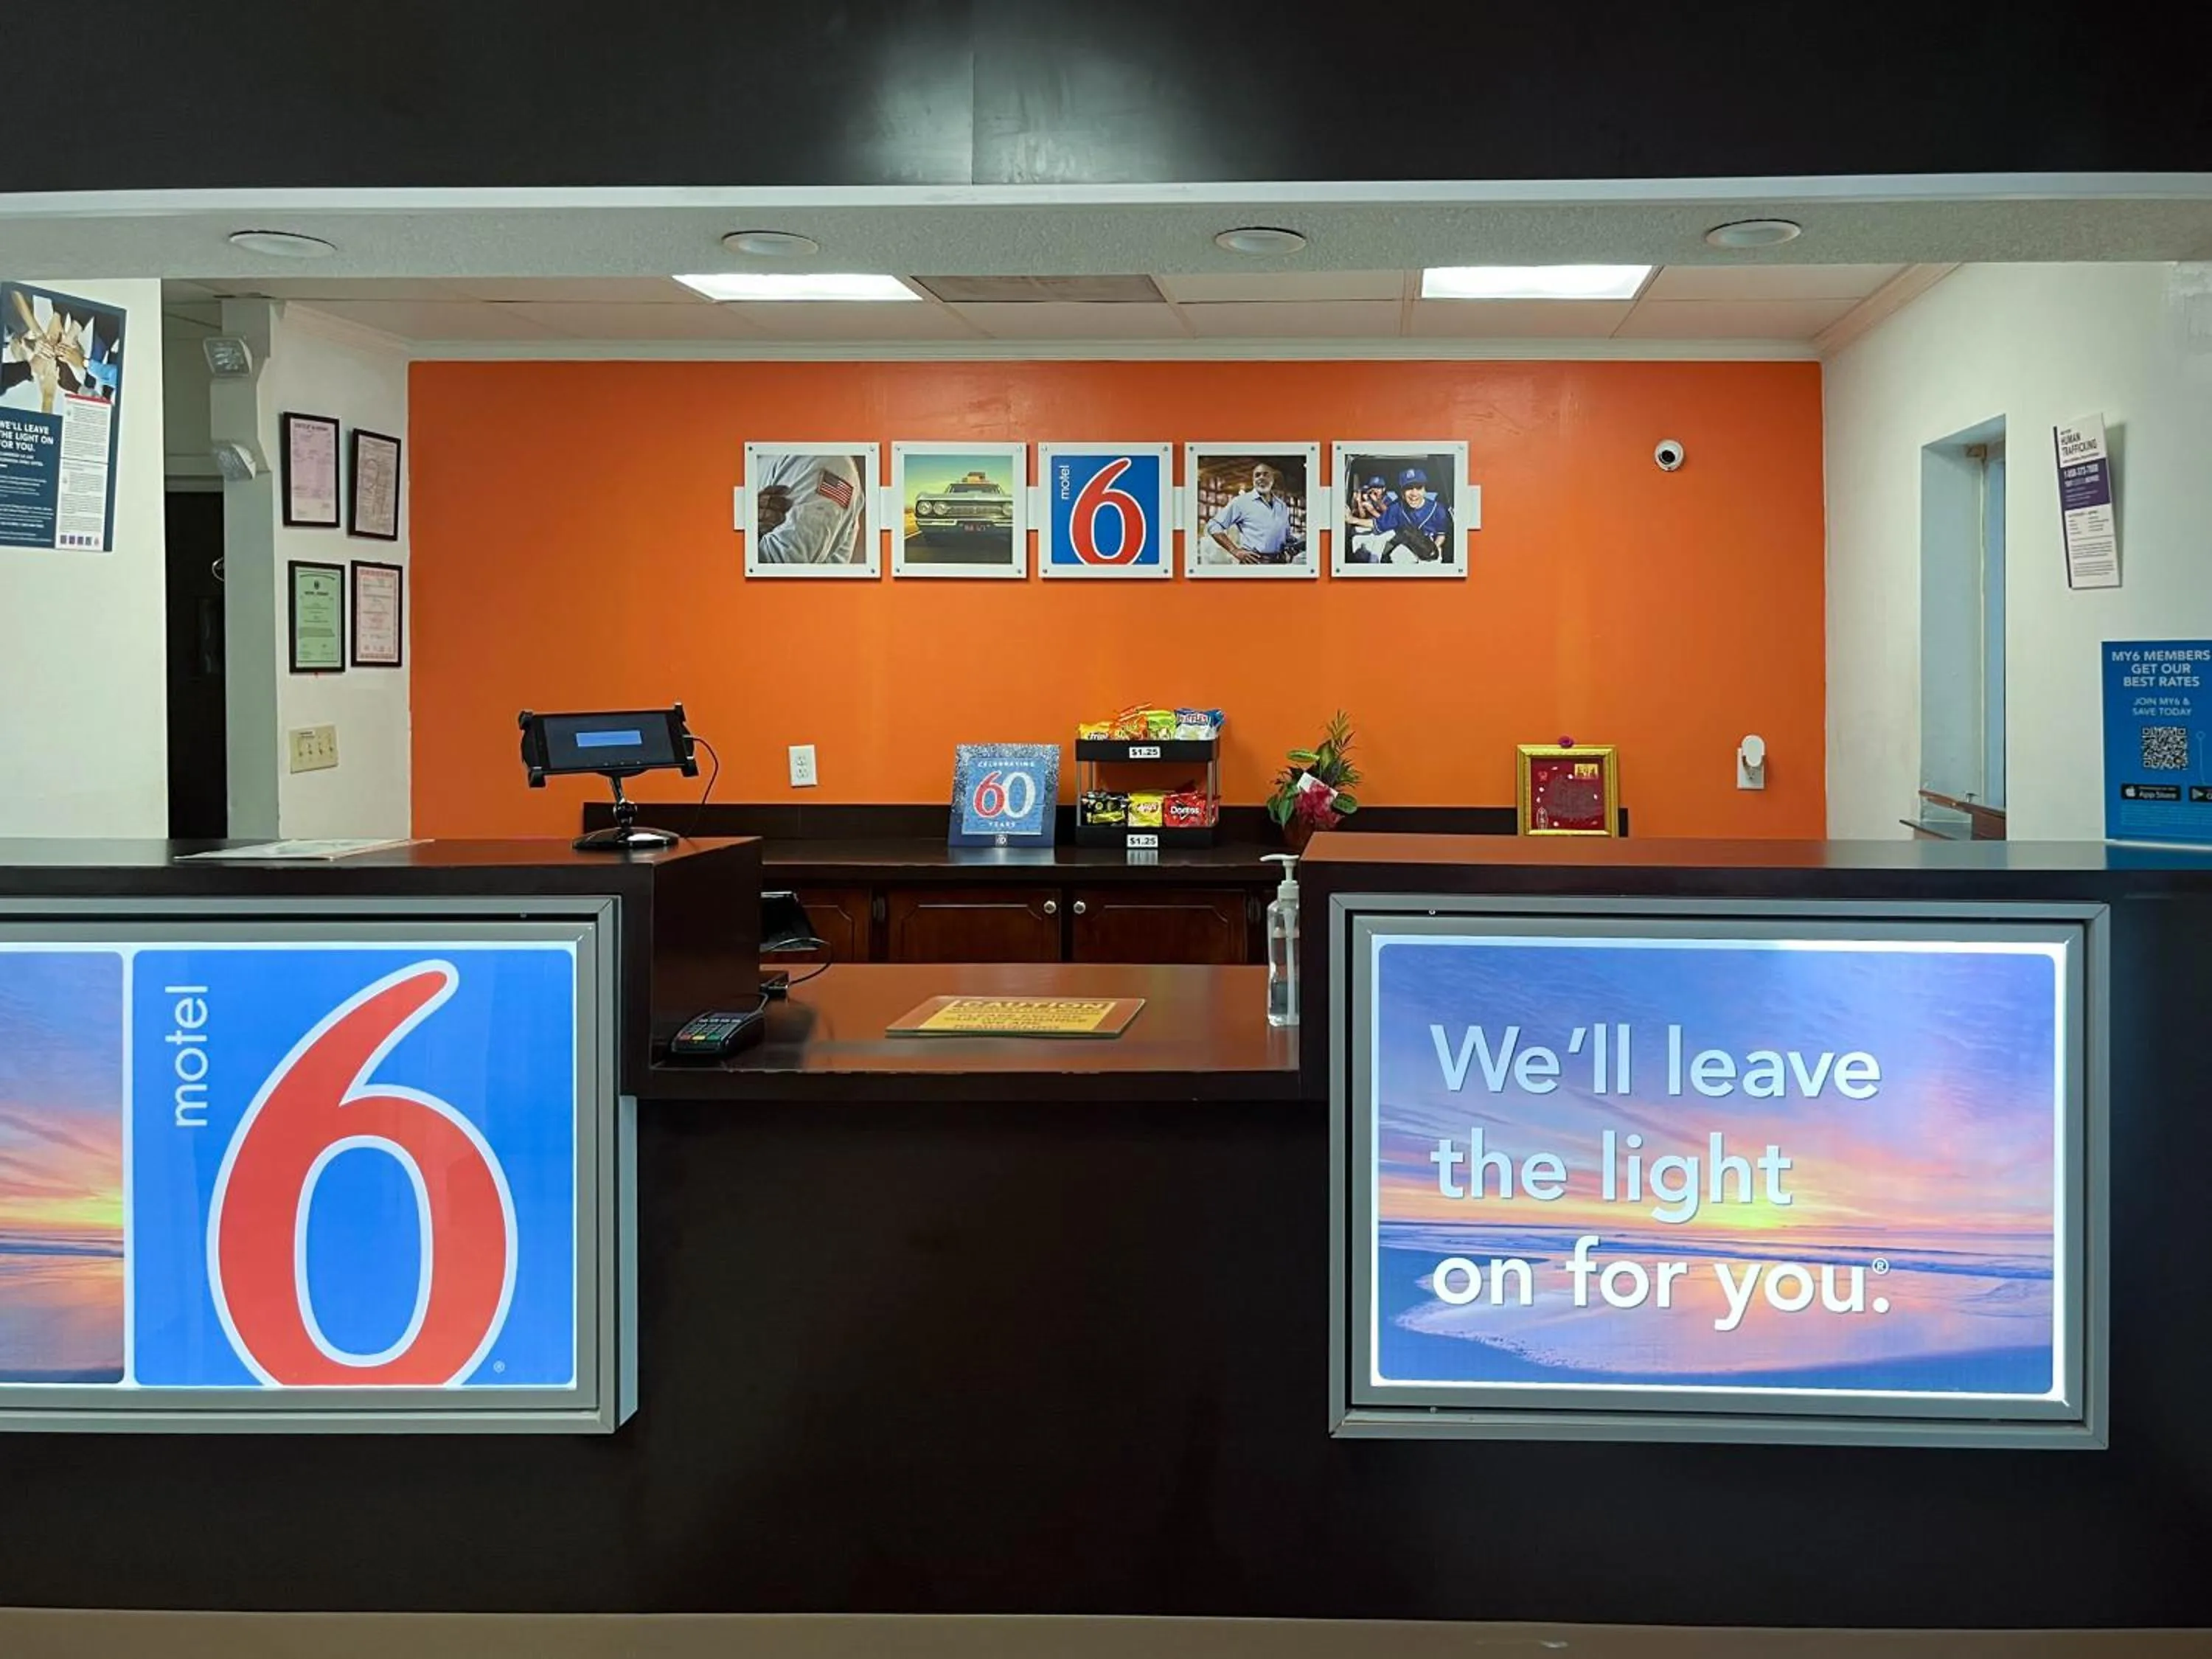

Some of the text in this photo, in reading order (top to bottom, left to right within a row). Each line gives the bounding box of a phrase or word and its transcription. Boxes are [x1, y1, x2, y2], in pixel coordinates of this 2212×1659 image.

[24, 423, 49, 435] LEAVE
[0, 439, 13, 449] OR
[15, 432, 39, 443] LIGHT
[41, 435, 54, 445] ON
[1059, 465, 1070, 500] motel
[1069, 457, 1147, 566] 6
[2111, 650, 2211, 661] MY6 MEMBERS
[2131, 663, 2191, 674] GET OUR
[2124, 676, 2200, 687] BEST RATES
[2134, 697, 2157, 706] JOIN
[2132, 707, 2192, 716] SAVE TODAY
[973, 770, 1036, 818] 60
[1129, 837, 1157, 845] $1.25
[164, 984, 208, 1128] motel
[1429, 1023, 1882, 1099] We'll leave
[206, 959, 519, 1389] 6
[1429, 1127, 1793, 1224] the light
[1432, 1255, 1534, 1306] on
[1565, 1235, 1688, 1308] for
